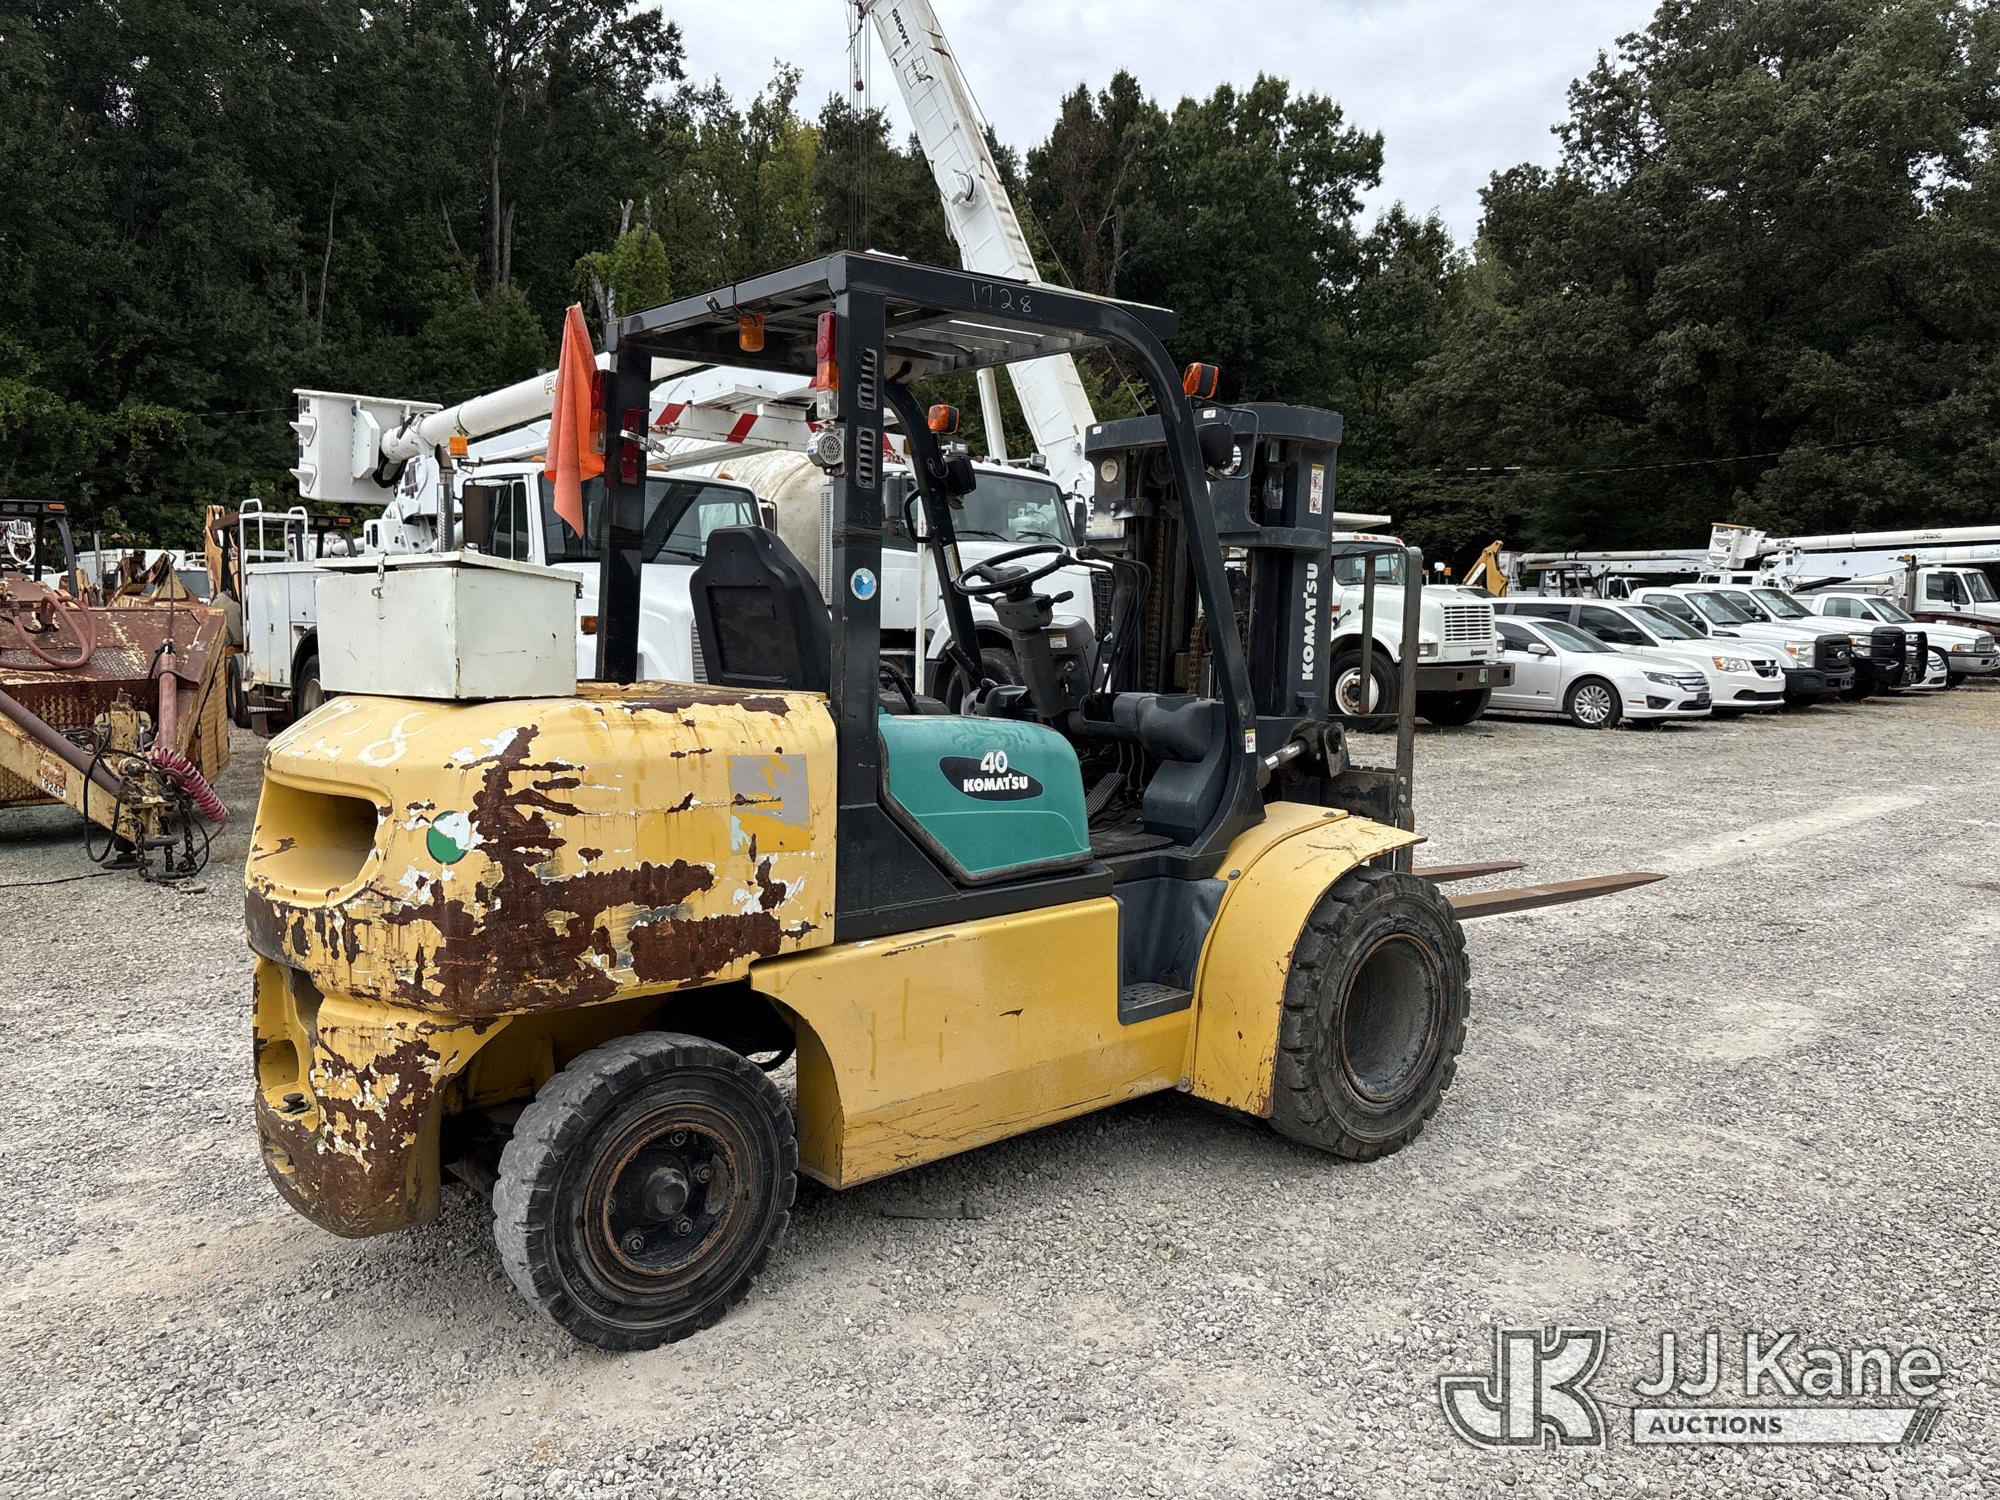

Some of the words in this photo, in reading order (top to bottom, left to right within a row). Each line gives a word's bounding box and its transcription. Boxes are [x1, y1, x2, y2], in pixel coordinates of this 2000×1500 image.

[892, 8, 911, 48] GROVE
[972, 281, 1031, 312] 1728
[1302, 563, 1318, 680] KOMATSU
[980, 750, 1008, 774] 40
[963, 773, 1028, 792] KOMATSU
